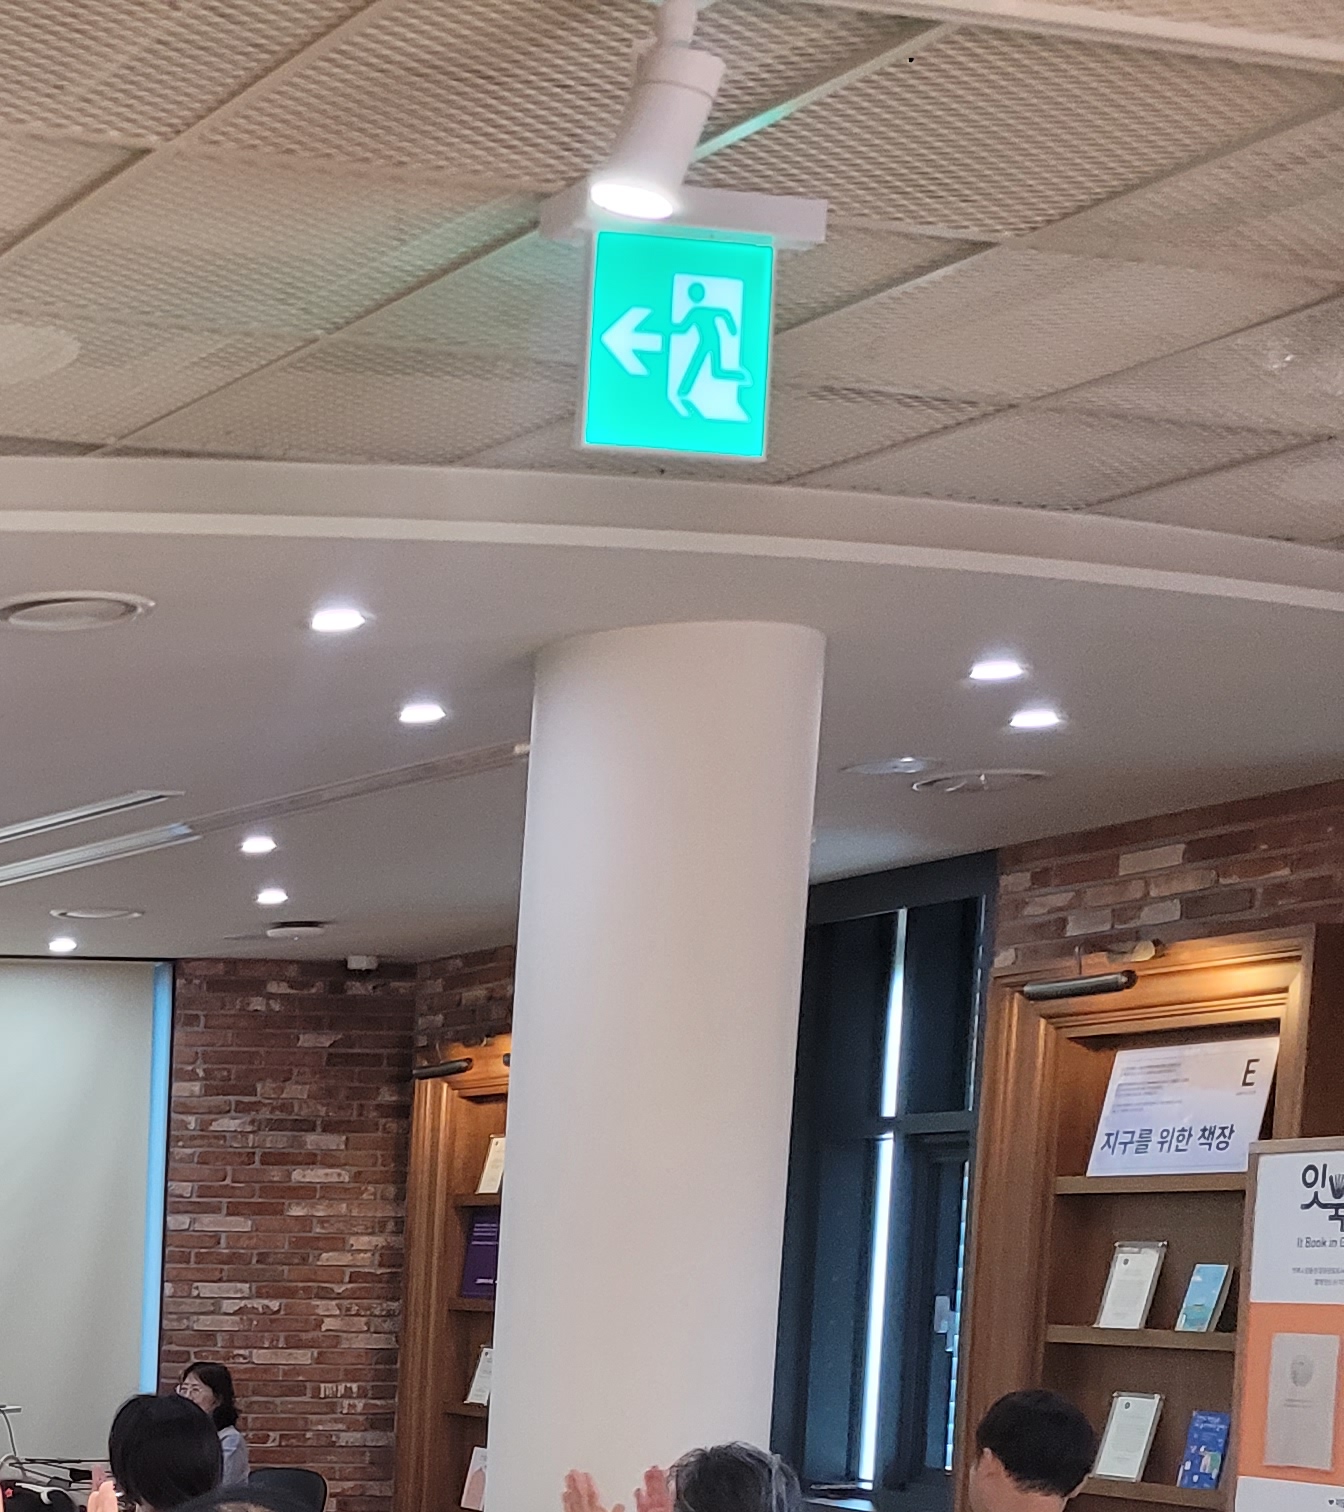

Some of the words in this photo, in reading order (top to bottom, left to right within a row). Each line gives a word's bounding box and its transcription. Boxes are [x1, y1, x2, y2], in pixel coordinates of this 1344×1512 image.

[1241, 1058, 1260, 1087] E
[1100, 1128, 1153, 1156] 지구를
[1157, 1126, 1193, 1154] 위한
[1197, 1124, 1236, 1151] 책장
